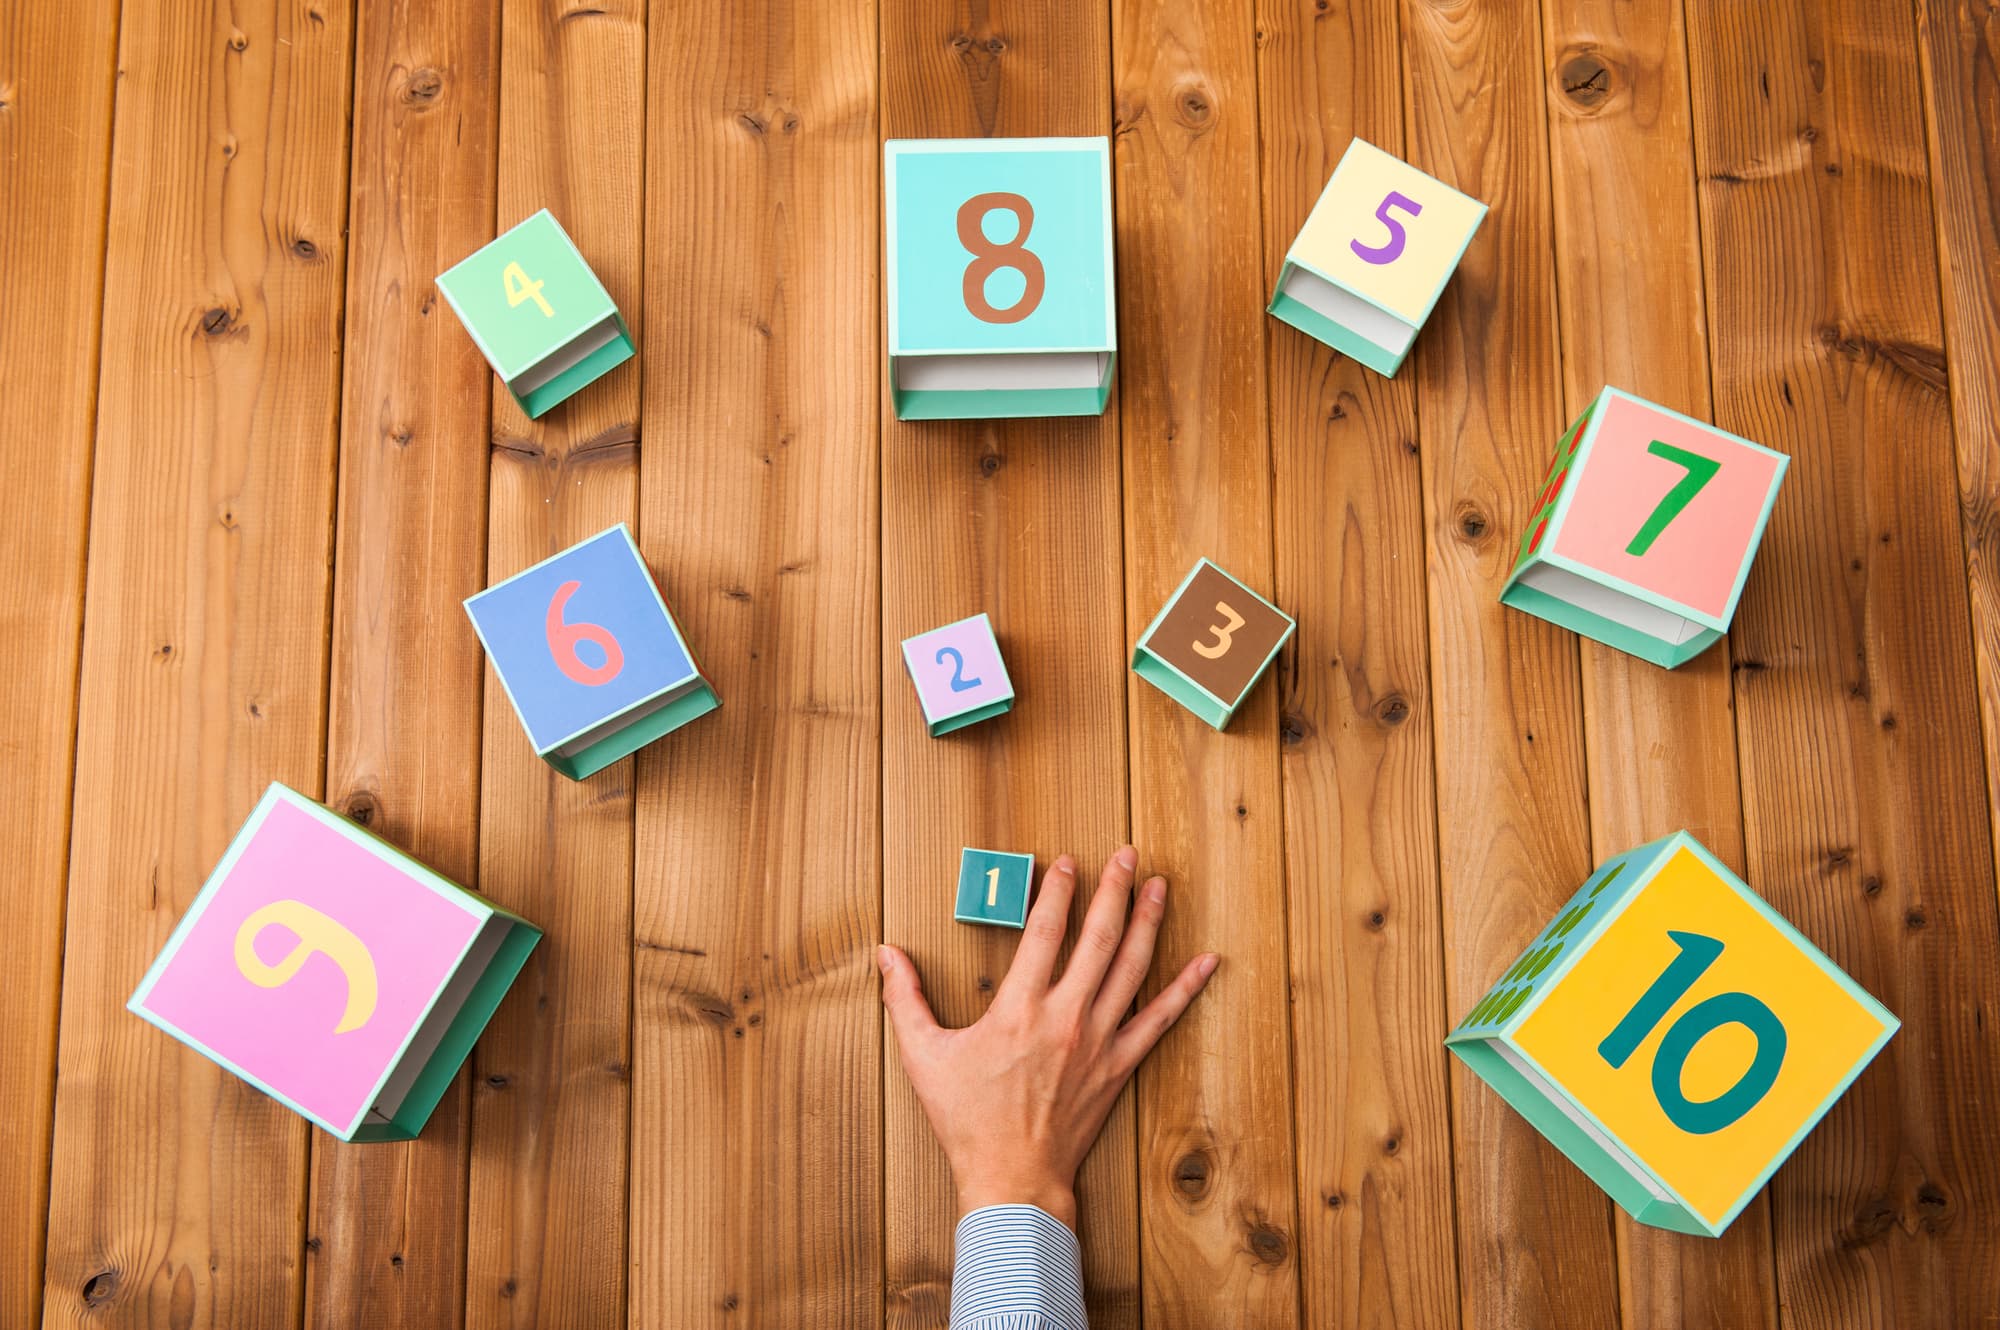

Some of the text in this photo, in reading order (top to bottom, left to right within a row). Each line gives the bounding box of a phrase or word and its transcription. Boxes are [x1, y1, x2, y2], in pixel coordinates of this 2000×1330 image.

[956, 191, 1046, 325] 8
[1350, 190, 1423, 265] 5
[503, 261, 555, 318] 4
[1625, 440, 1722, 557] 7
[545, 581, 625, 687] 6
[935, 647, 983, 693] 2
[1192, 601, 1246, 660] 3
[985, 867, 1001, 908] 1
[233, 899, 378, 1035] 9
[1597, 930, 1788, 1135] 10
